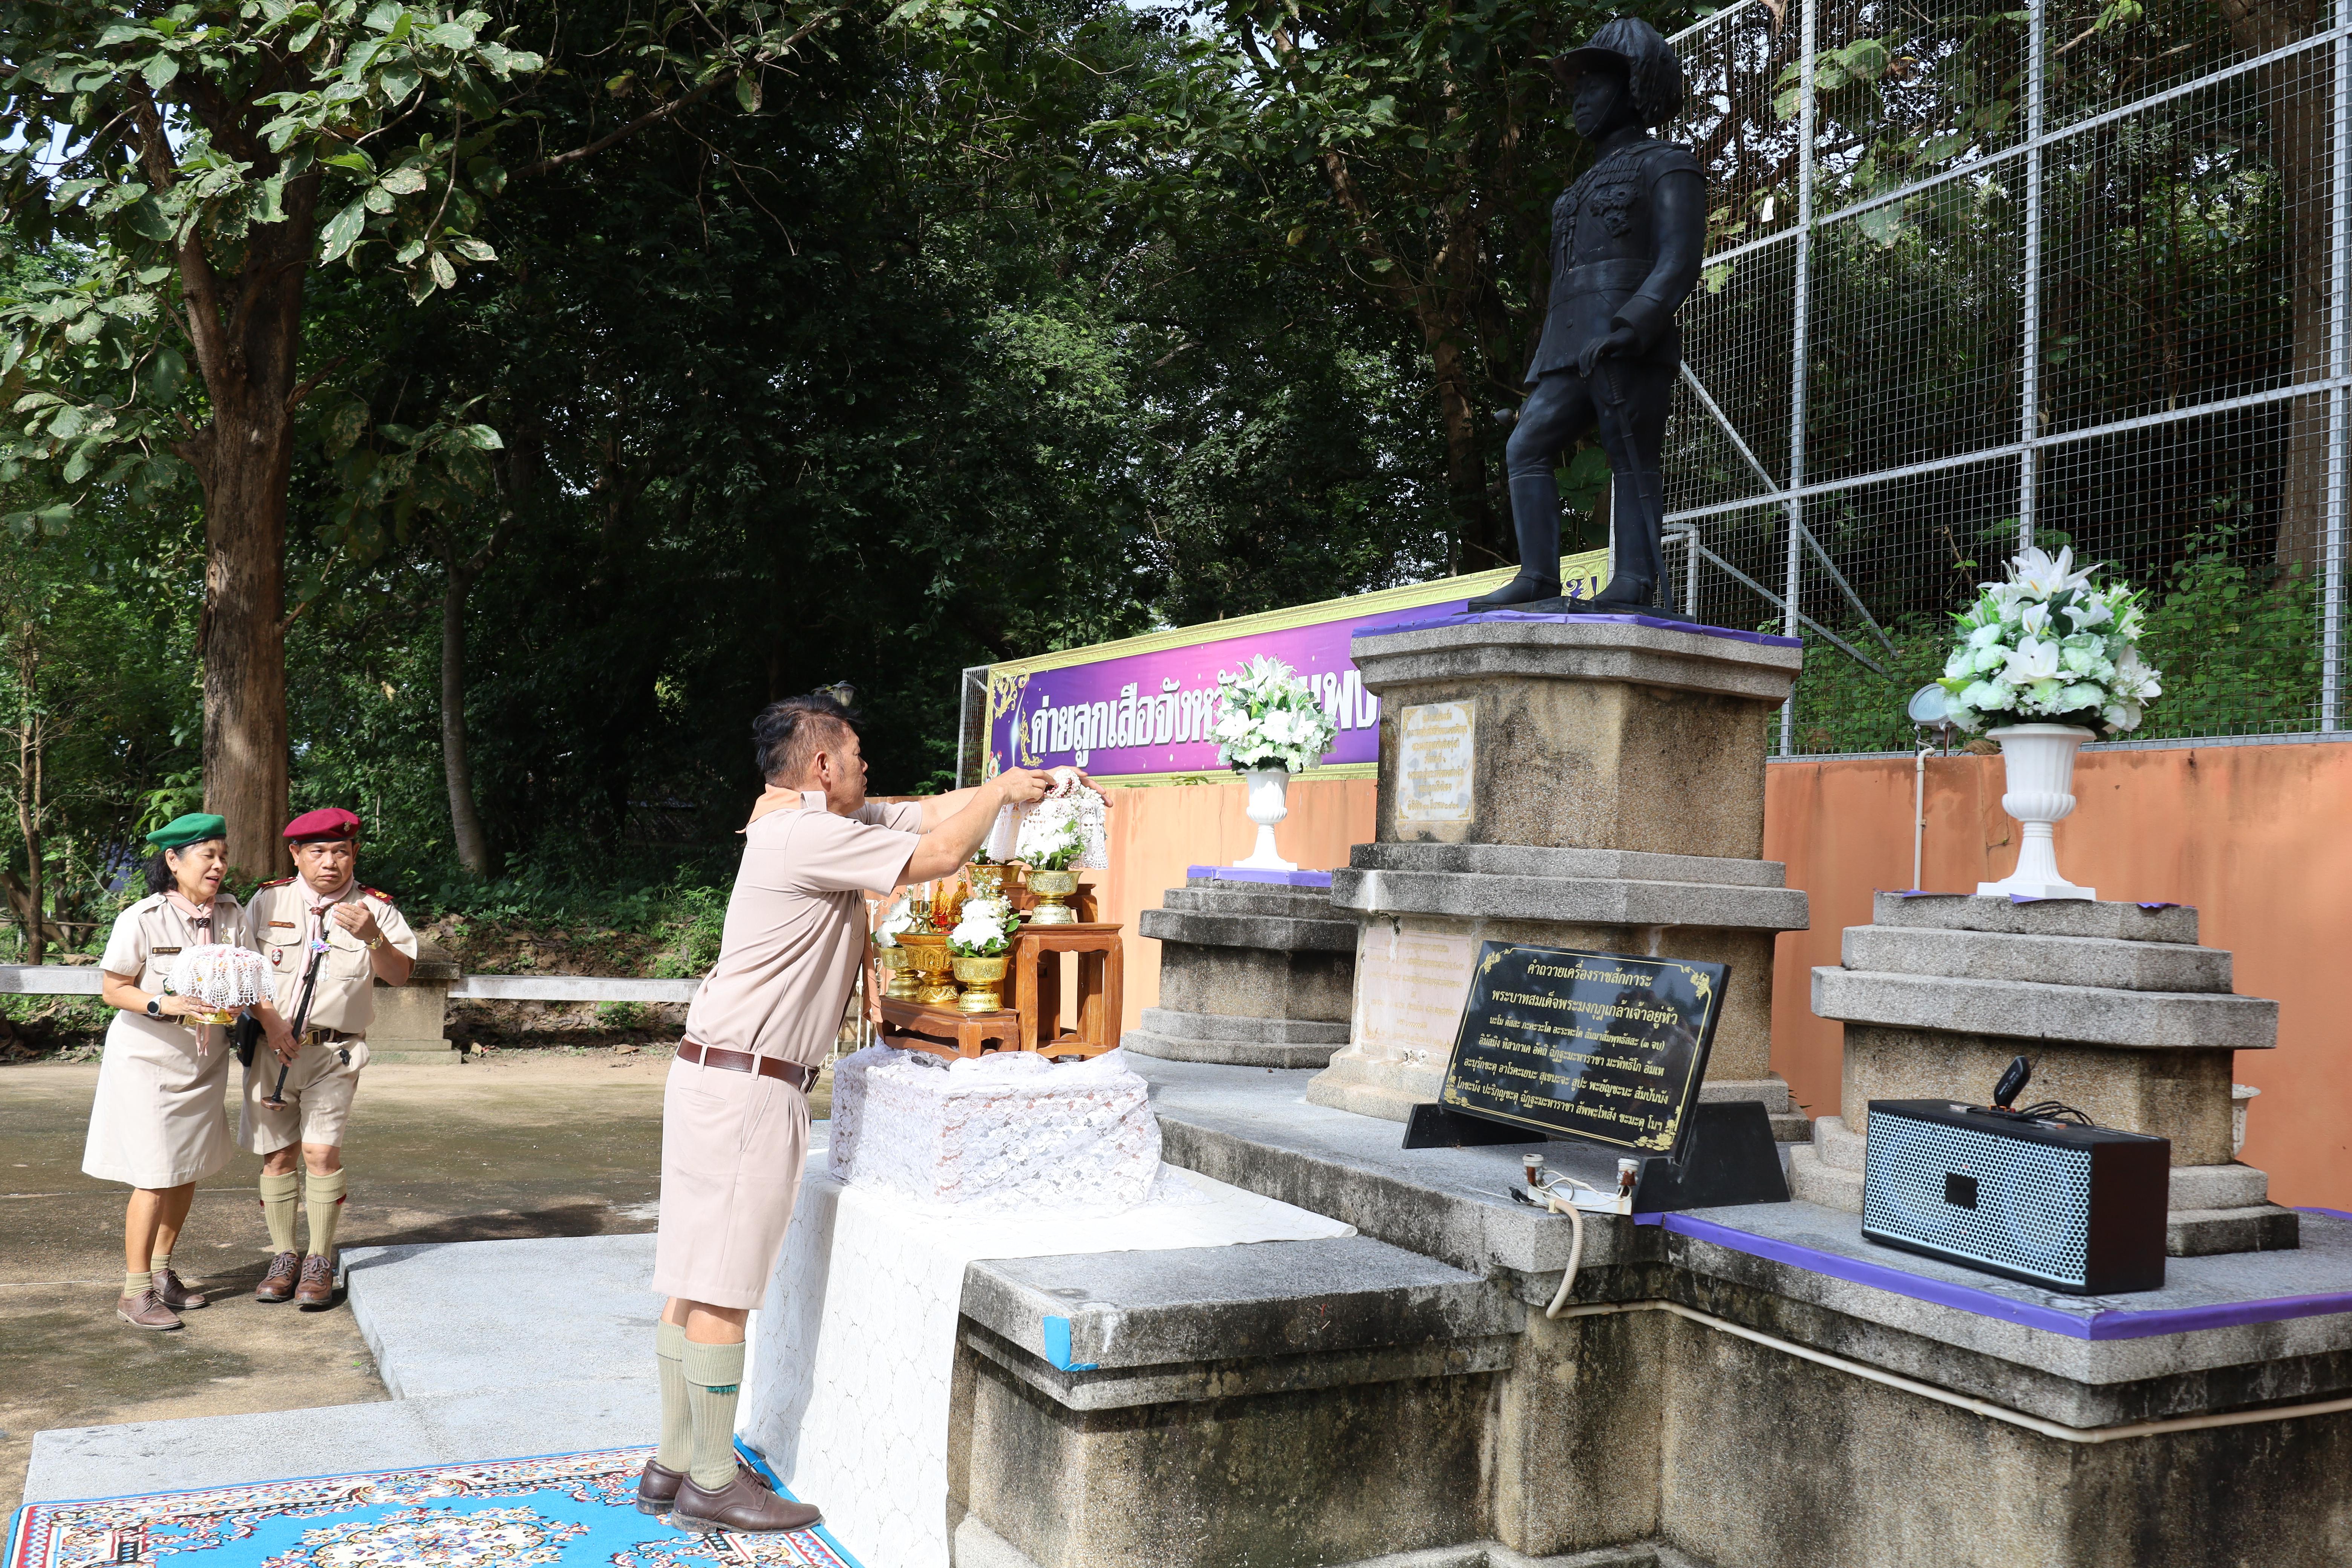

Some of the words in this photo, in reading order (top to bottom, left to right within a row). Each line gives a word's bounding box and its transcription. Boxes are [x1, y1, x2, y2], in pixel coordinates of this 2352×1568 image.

[1527, 959, 1653, 987] คำถวายเครื่องราชสักการะ
[1492, 988, 1678, 1029] พระบาทสมเด็จพระมงกุฎเกล้าเจ้าอยู่หัว
[1479, 1033, 1500, 1047] อิมัสมิง
[1502, 1037, 1531, 1054] ทิสาภาเค
[1490, 1014, 1504, 1025] นะโม
[1505, 1016, 1520, 1028] ตัสสะ
[1521, 1021, 1551, 1033] ภะคะวะโต
[1585, 1028, 1639, 1047] สัมมาสัมพุทธัสสะ
[1652, 1040, 1665, 1051] จบ)
[1464, 1056, 1497, 1075] อะนุรักขะตุ
[1499, 1061, 1538, 1080] อาโรคะเยนะ
[1589, 1078, 1633, 1097] พะยัญชะนะ
[1482, 1083, 1519, 1105] ปะริภุญชะตุ
[1576, 1101, 1617, 1121] สัพพะโทสัง
